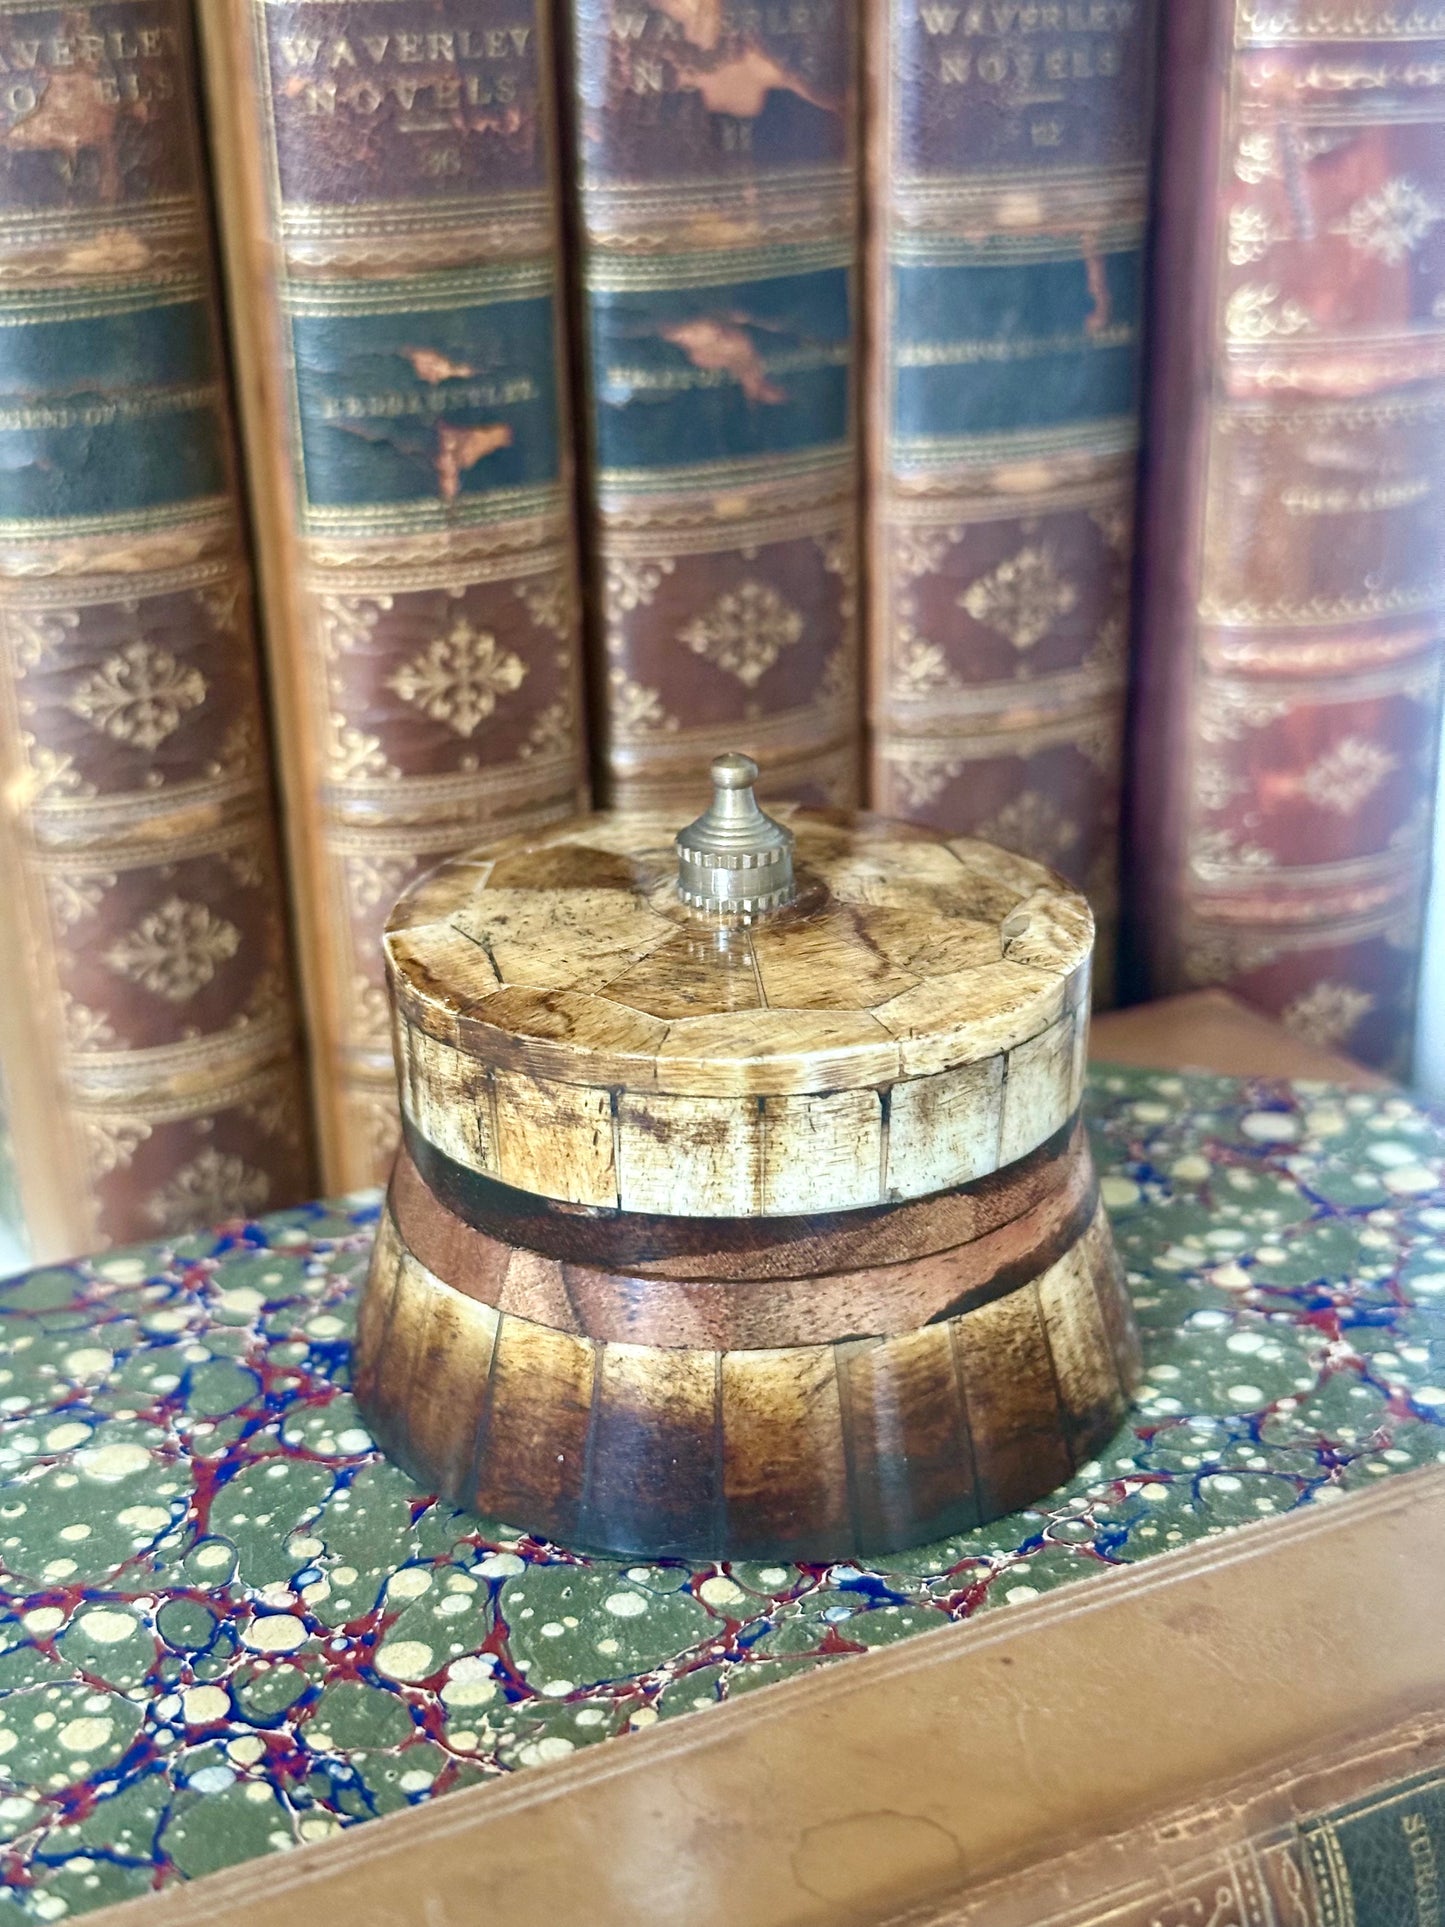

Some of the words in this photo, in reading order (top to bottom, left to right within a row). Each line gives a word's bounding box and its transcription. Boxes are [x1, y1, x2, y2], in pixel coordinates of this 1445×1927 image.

[920, 3, 1132, 36] WAVERLEY
[280, 27, 531, 67] WAVERLEY
[938, 48, 1122, 84] NOVELS
[303, 76, 517, 115] NOVELS
